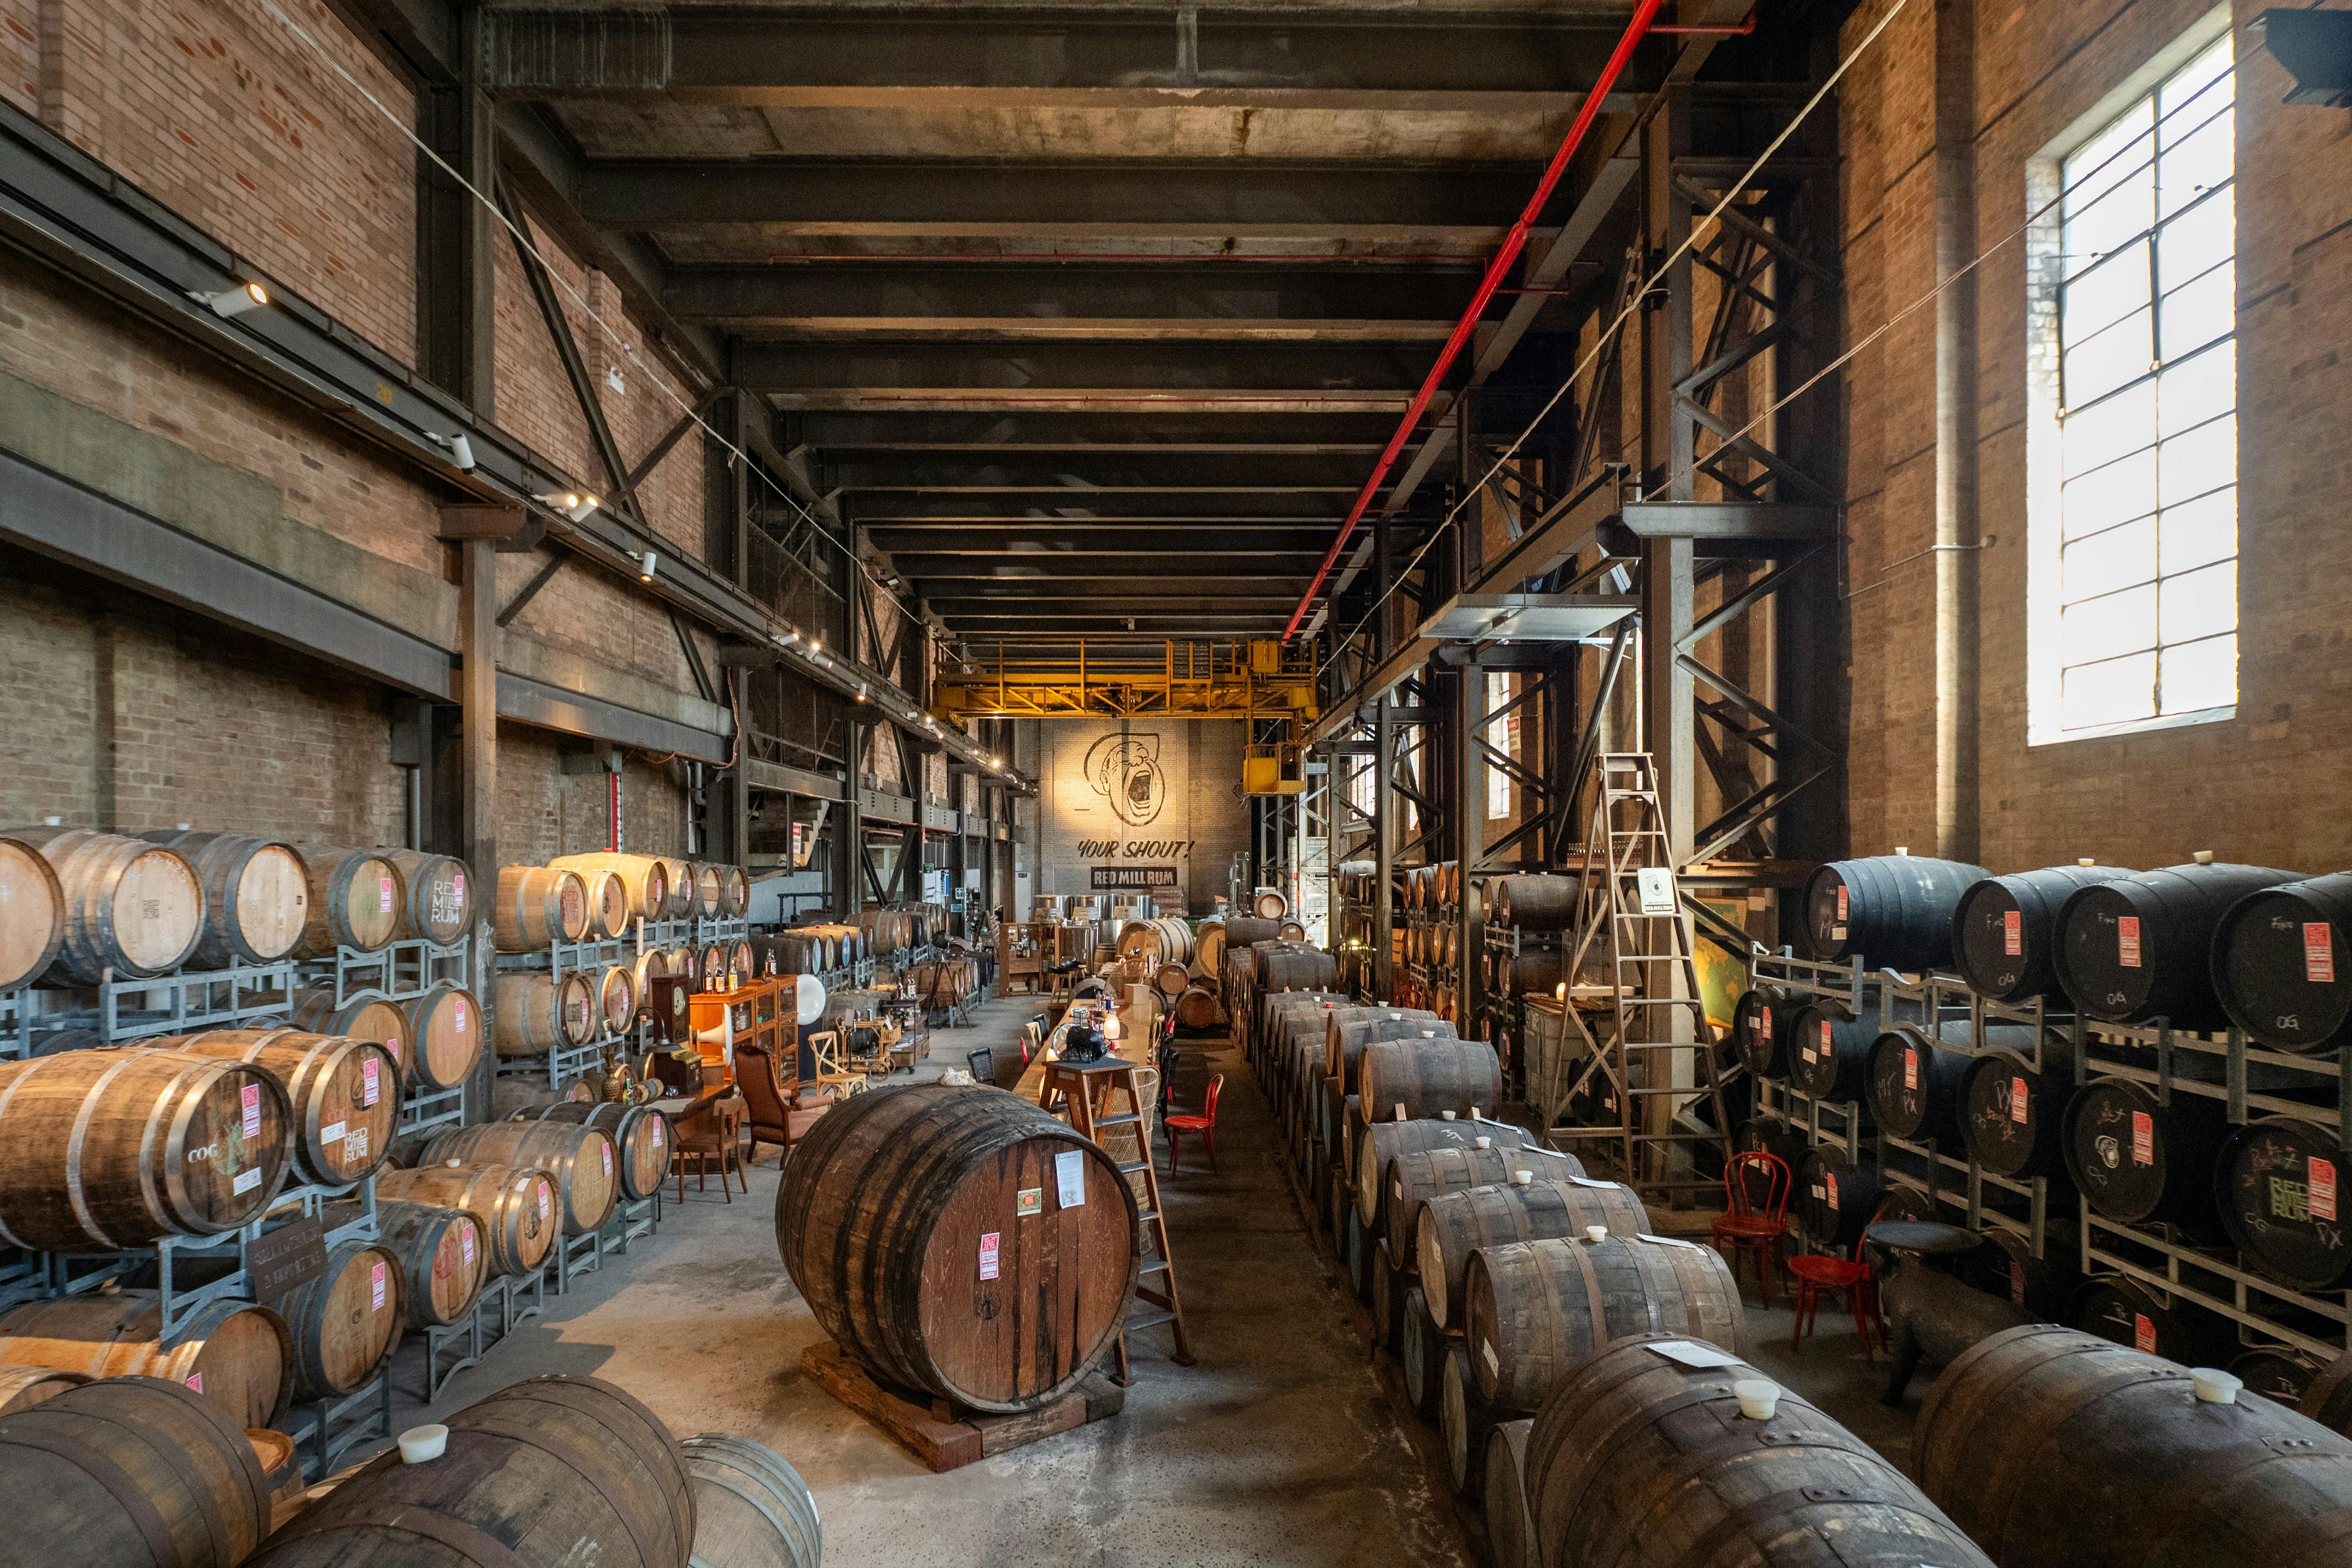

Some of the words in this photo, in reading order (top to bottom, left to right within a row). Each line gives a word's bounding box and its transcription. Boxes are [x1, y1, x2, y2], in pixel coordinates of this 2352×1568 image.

[1077, 839, 1119, 858] YOUR
[1122, 840, 1196, 858] SHOUT!
[1094, 871, 1116, 884] RED
[1118, 871, 1145, 884] MILL
[1147, 871, 1174, 885] RUM
[561, 891, 578, 901] RED
[431, 908, 460, 925] RUM
[346, 1127, 368, 1144] RED
[345, 1149, 368, 1164] RUM
